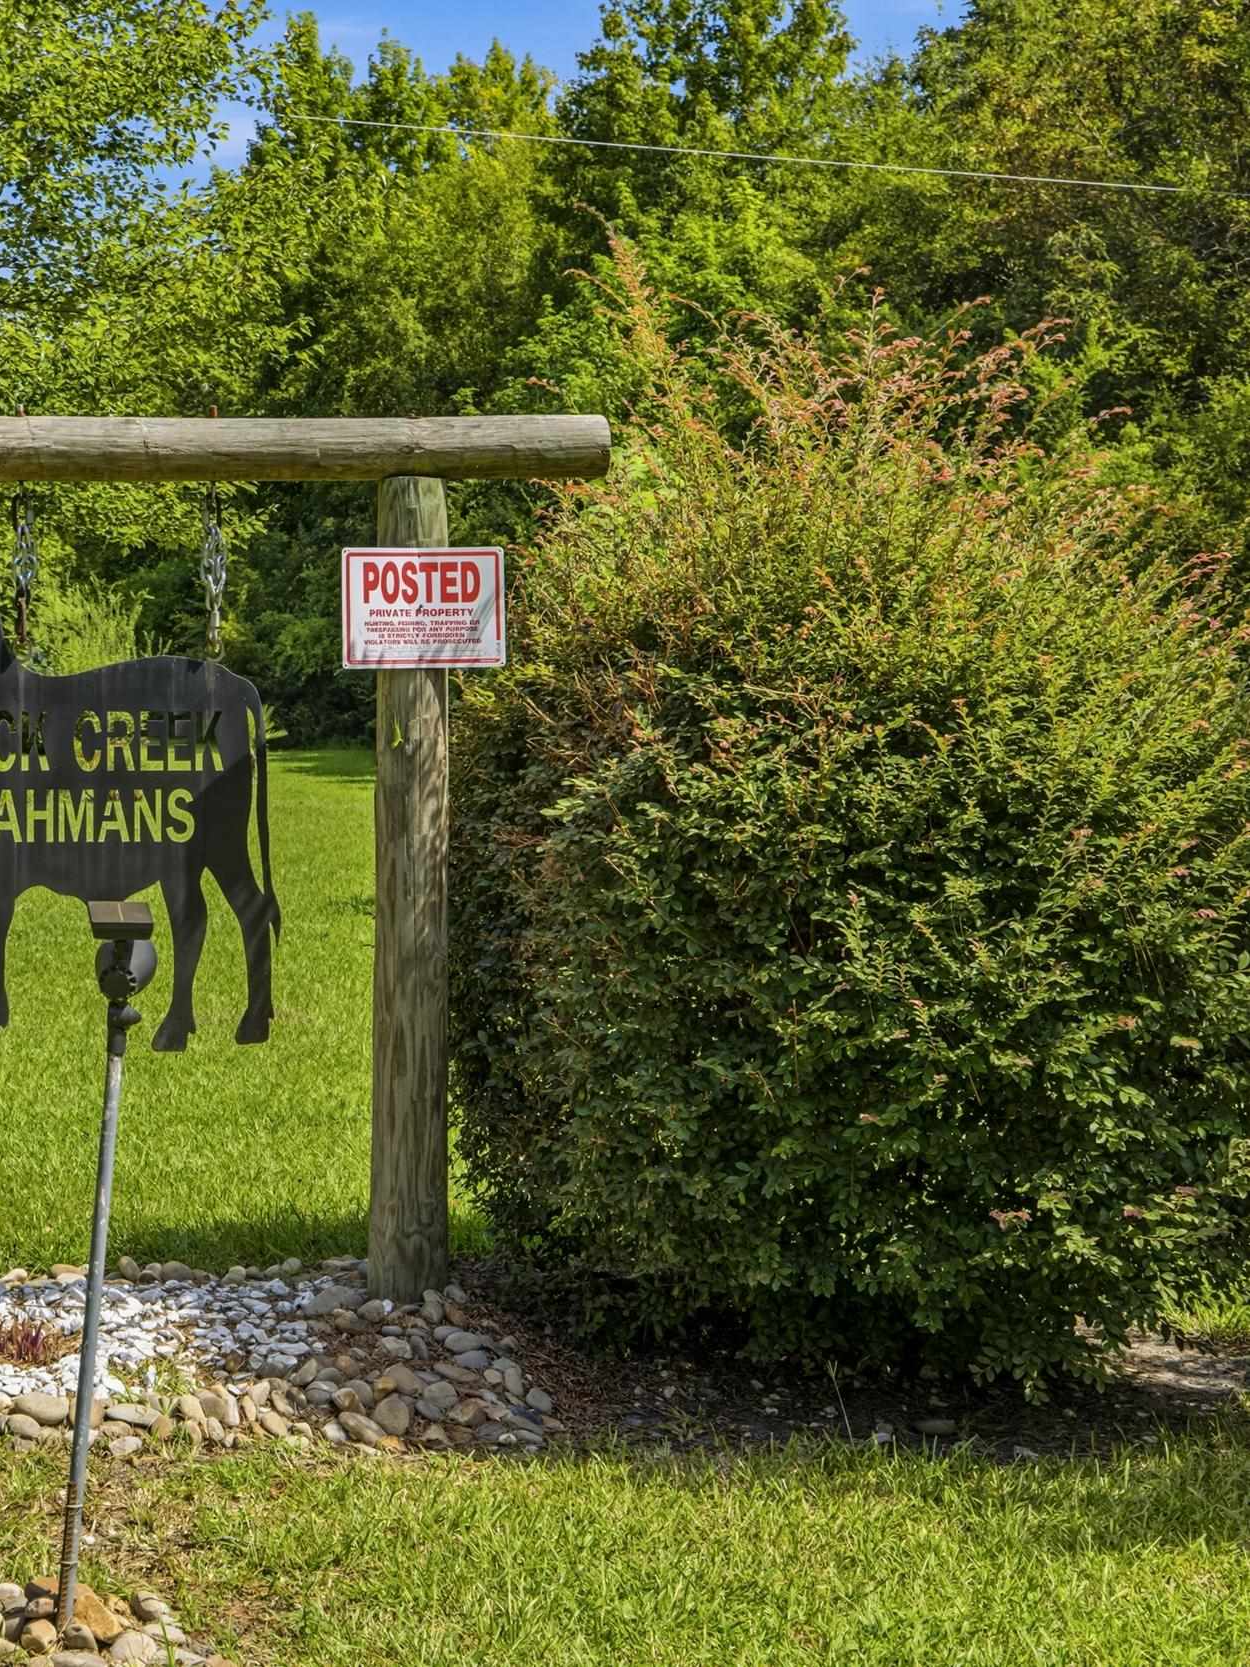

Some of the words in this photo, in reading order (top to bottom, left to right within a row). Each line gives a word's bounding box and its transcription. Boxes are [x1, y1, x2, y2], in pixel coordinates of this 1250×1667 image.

[363, 561, 481, 604] POSTED
[369, 608, 412, 617] PRIVATE
[415, 608, 474, 617] PROPERTY
[72, 709, 224, 772] CREEK
